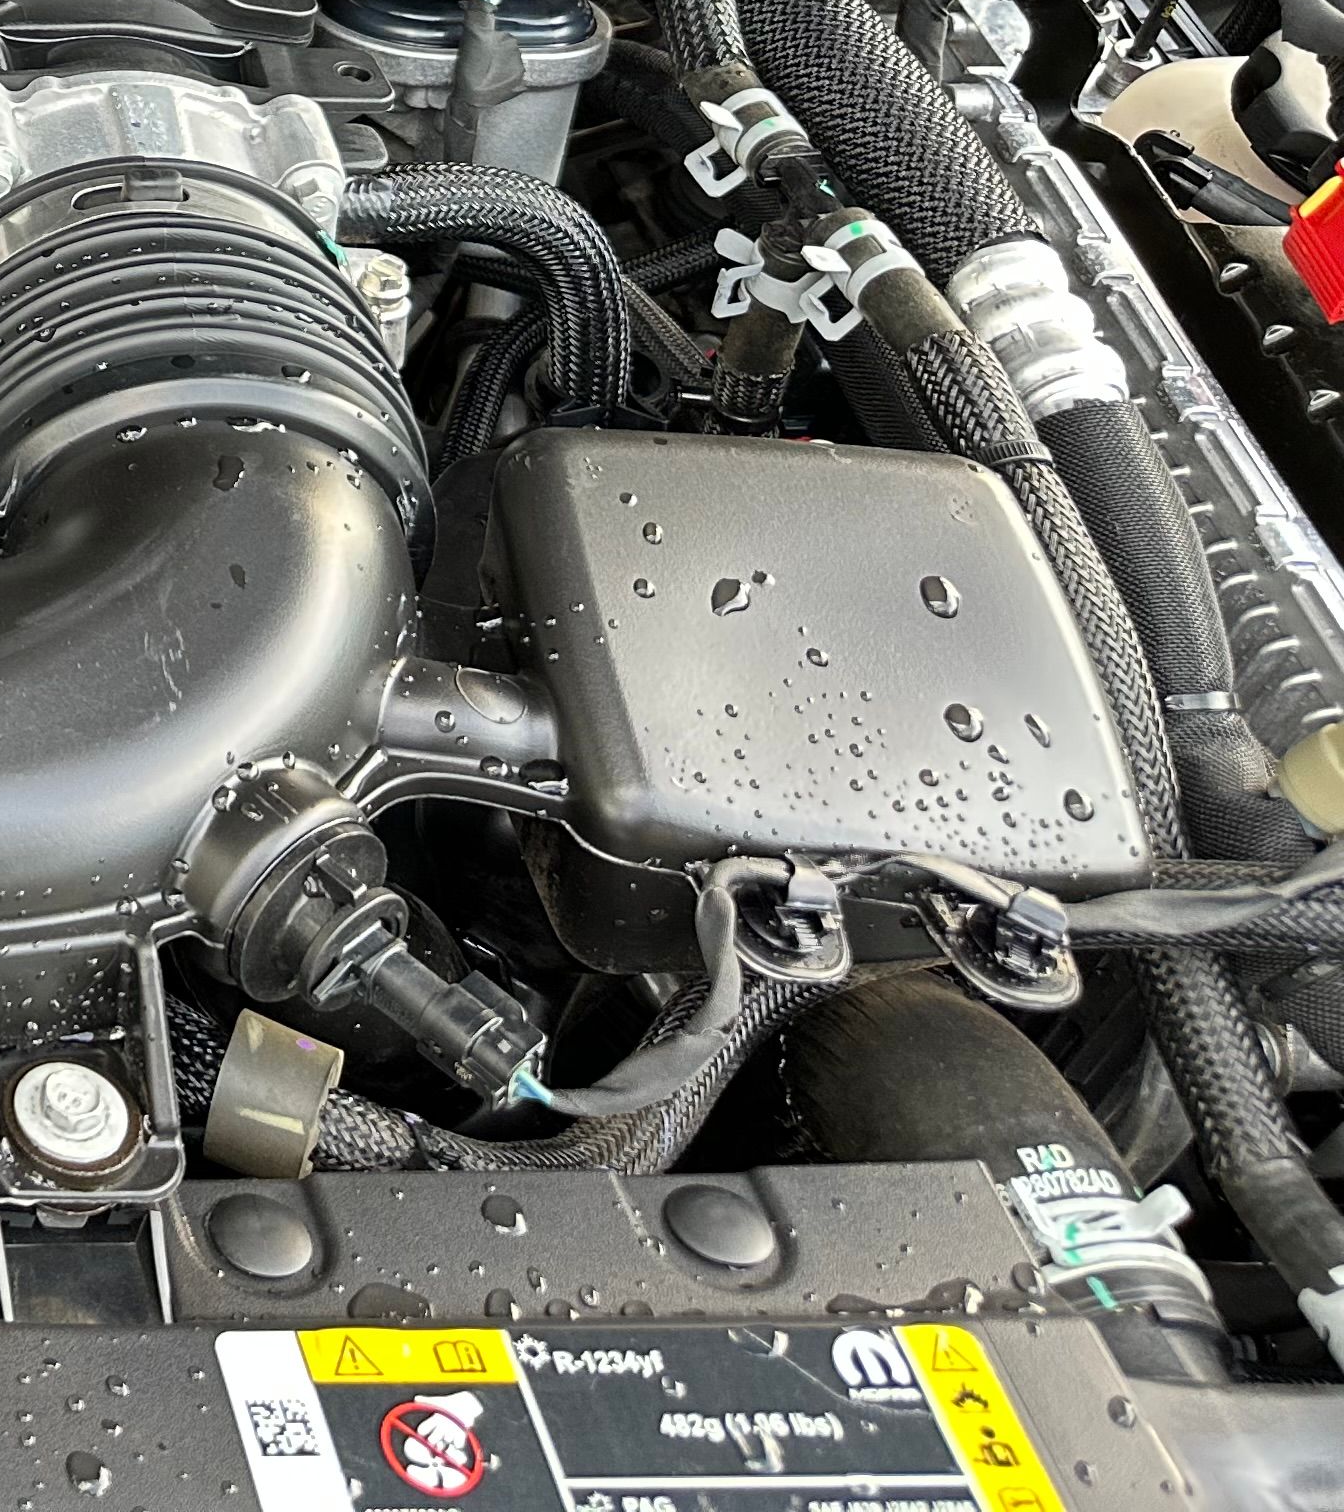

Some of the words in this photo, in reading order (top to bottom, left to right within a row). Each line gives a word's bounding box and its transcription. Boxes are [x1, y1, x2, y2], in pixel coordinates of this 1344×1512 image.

[1016, 1143, 1075, 1173] RAD
[552, 1348, 665, 1379] R-1234yf
[659, 1413, 726, 1443] 482g
